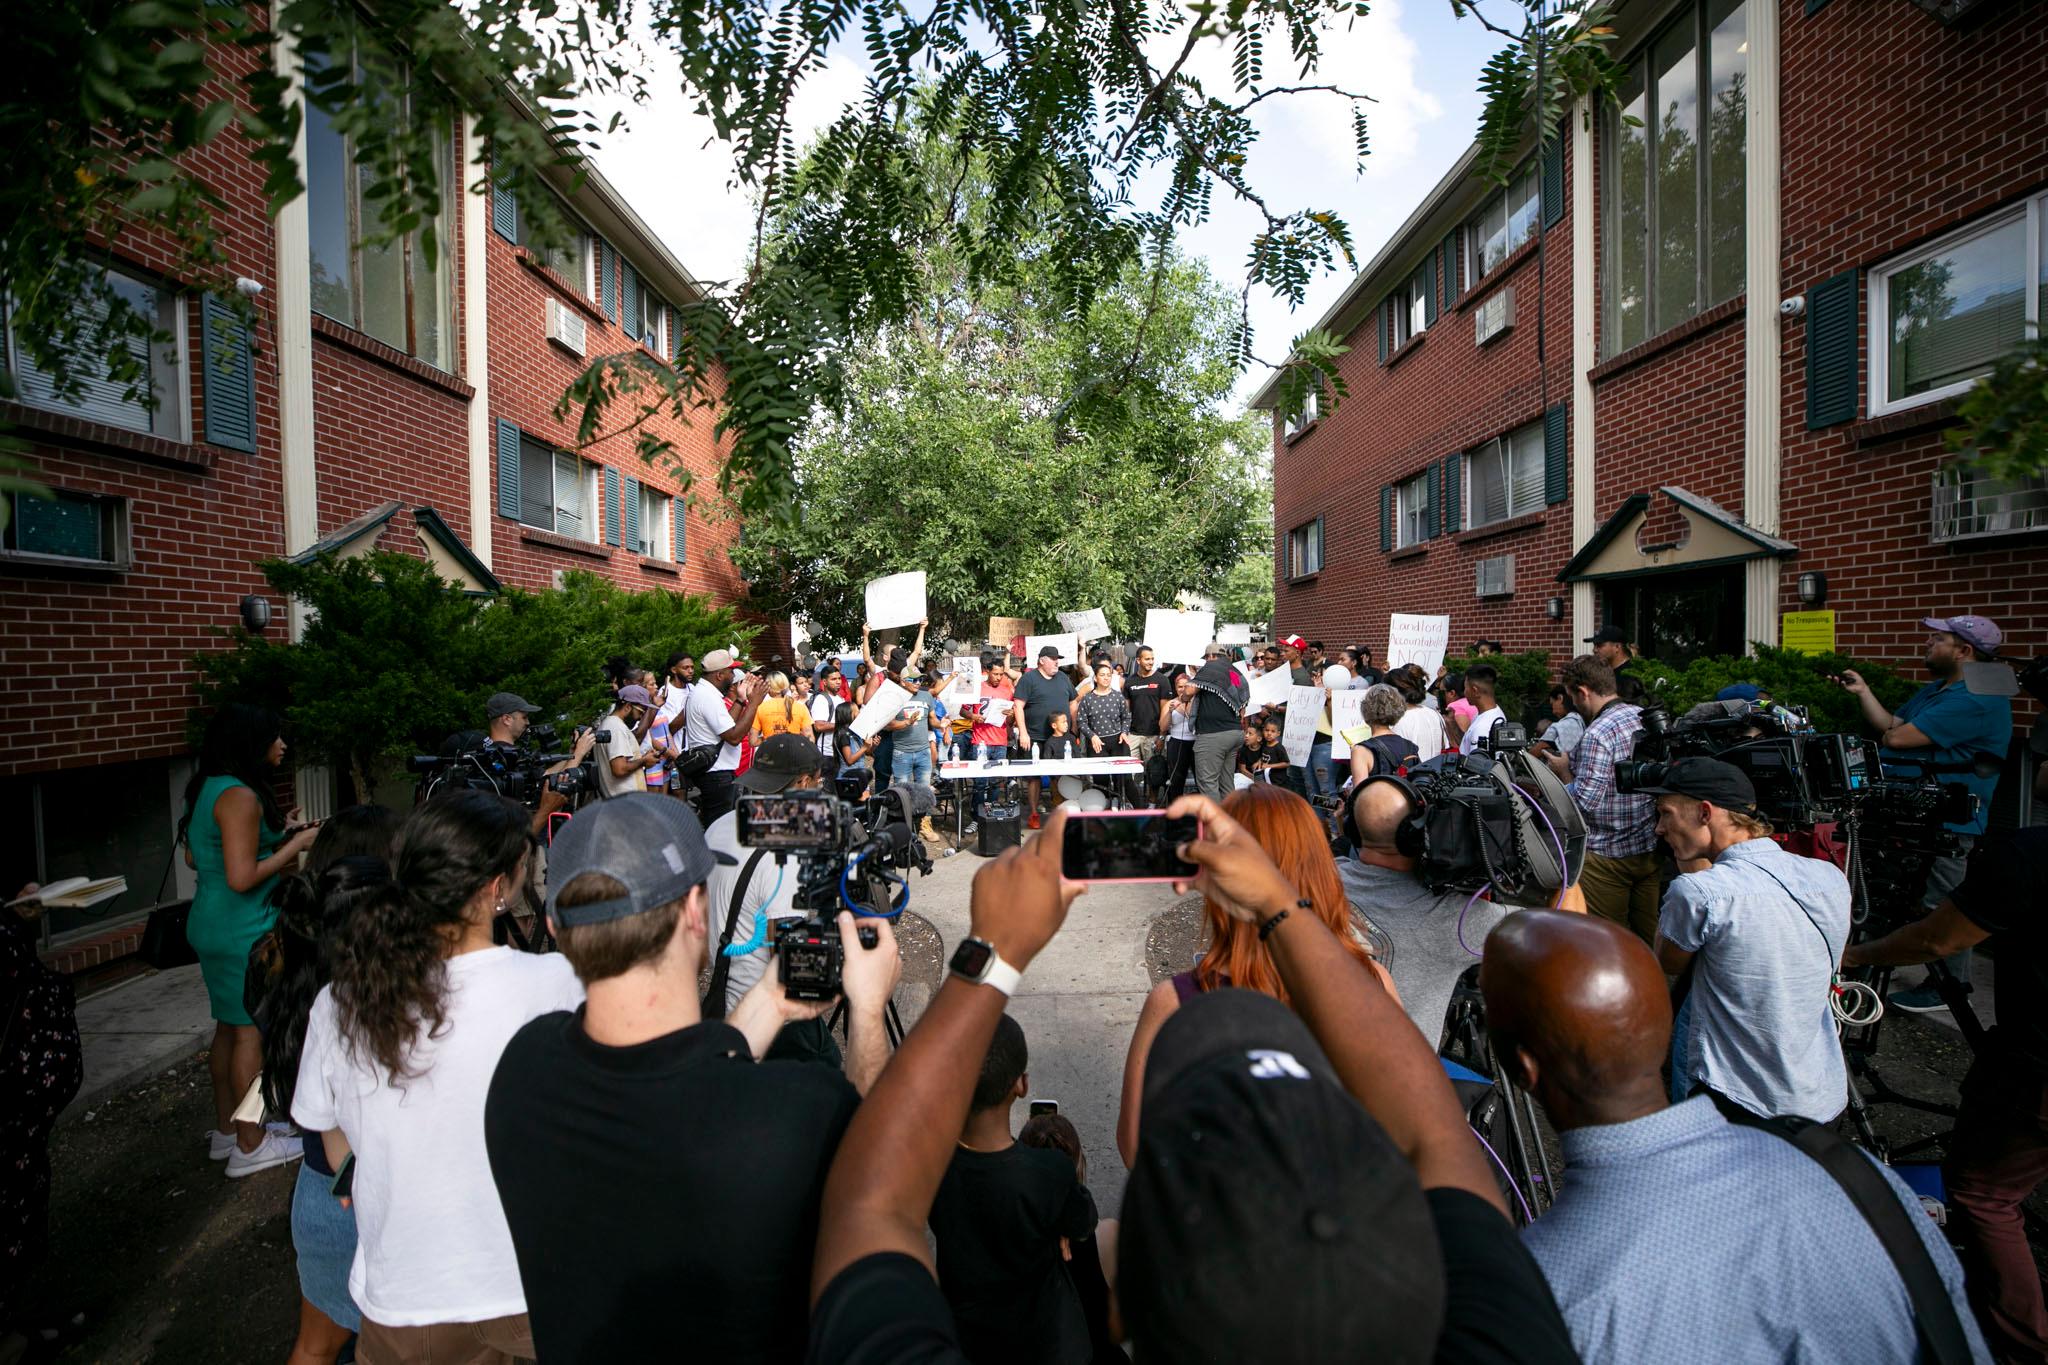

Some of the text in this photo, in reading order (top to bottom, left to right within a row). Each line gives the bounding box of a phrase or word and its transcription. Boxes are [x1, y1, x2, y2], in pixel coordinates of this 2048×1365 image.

[1392, 618, 1443, 632] Landlord
[1398, 649, 1440, 669] NOT
[1289, 687, 1310, 709] City
